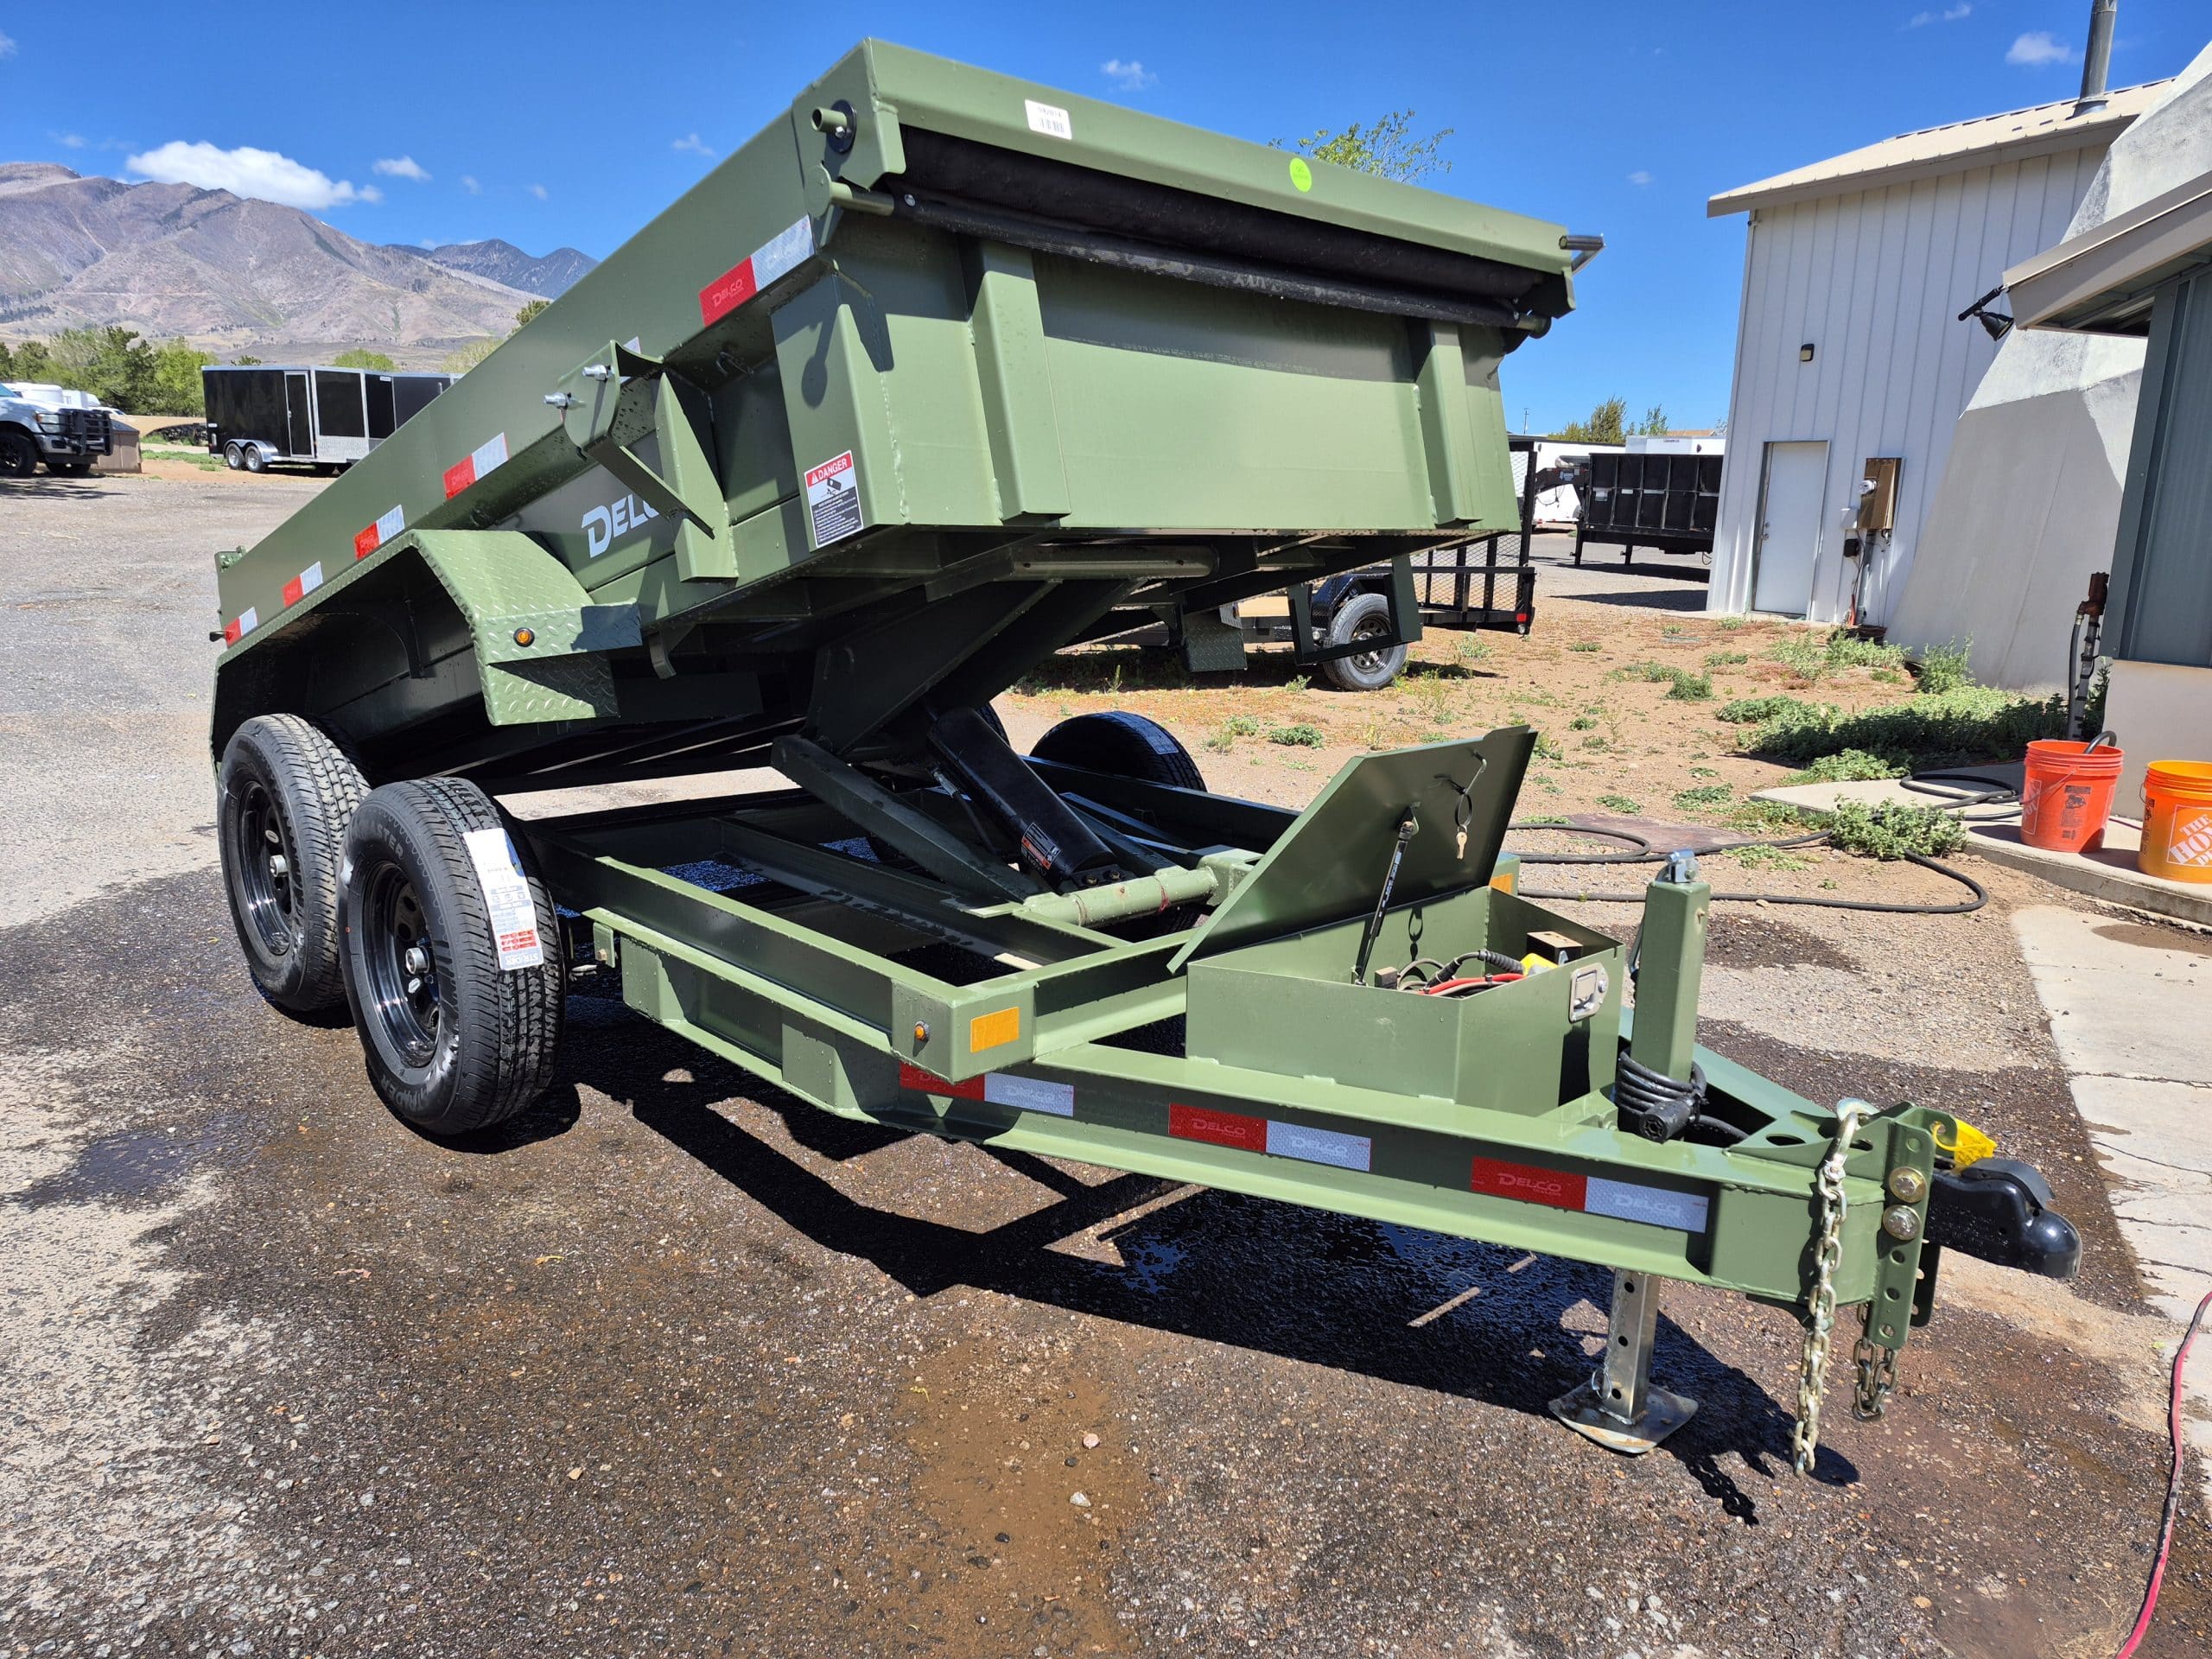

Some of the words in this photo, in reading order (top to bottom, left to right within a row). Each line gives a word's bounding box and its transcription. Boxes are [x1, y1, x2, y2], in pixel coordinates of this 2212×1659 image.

[818, 458, 848, 481] DANGER
[2179, 814, 2211, 836] THE
[1192, 1118, 1246, 1135] DELCO
[1497, 1173, 1562, 1192] DELCO
